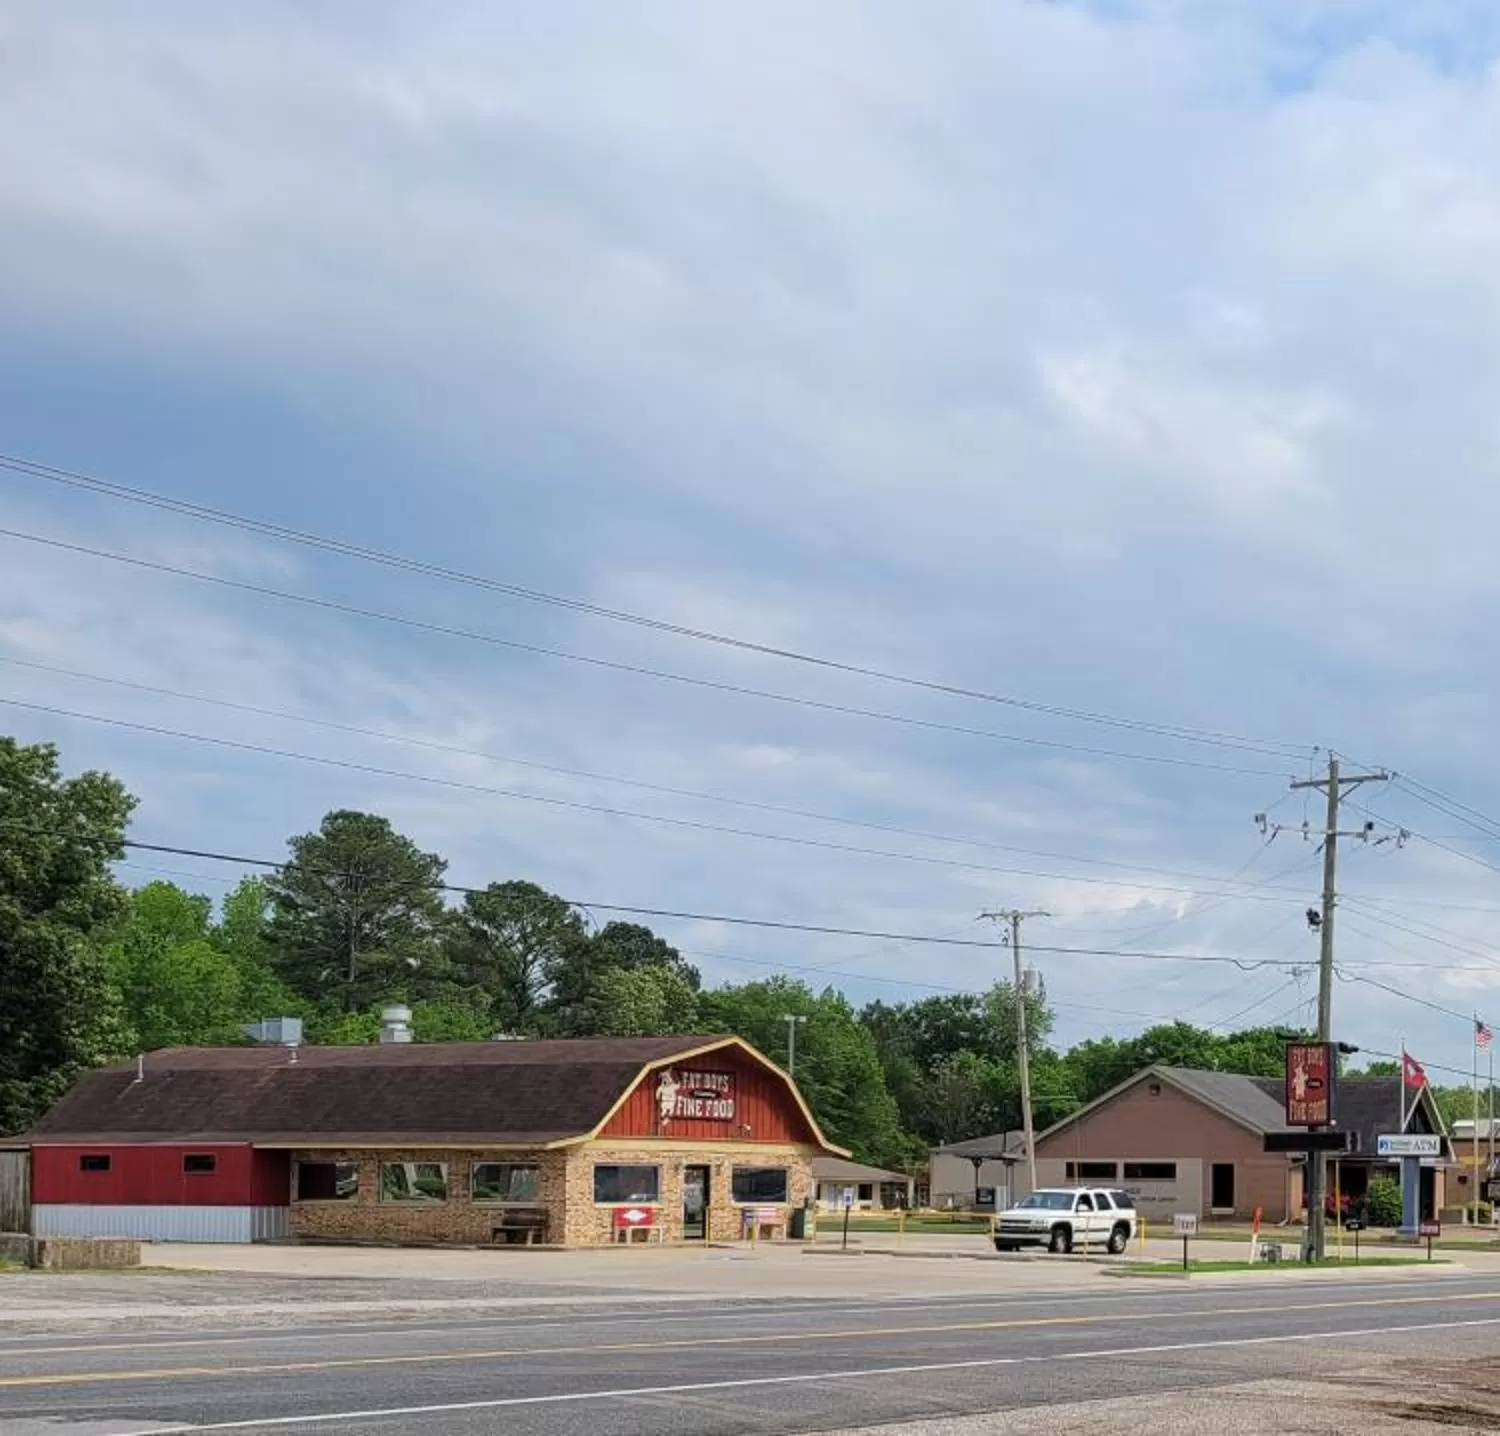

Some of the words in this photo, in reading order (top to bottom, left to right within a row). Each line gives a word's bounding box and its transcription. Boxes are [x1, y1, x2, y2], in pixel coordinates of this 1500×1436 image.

[681, 1071, 702, 1089] FAT
[703, 1073, 729, 1093] BOYS
[676, 1095, 703, 1117] FINE
[705, 1099, 735, 1118] FOOD
[1411, 1139, 1438, 1152] ATM
